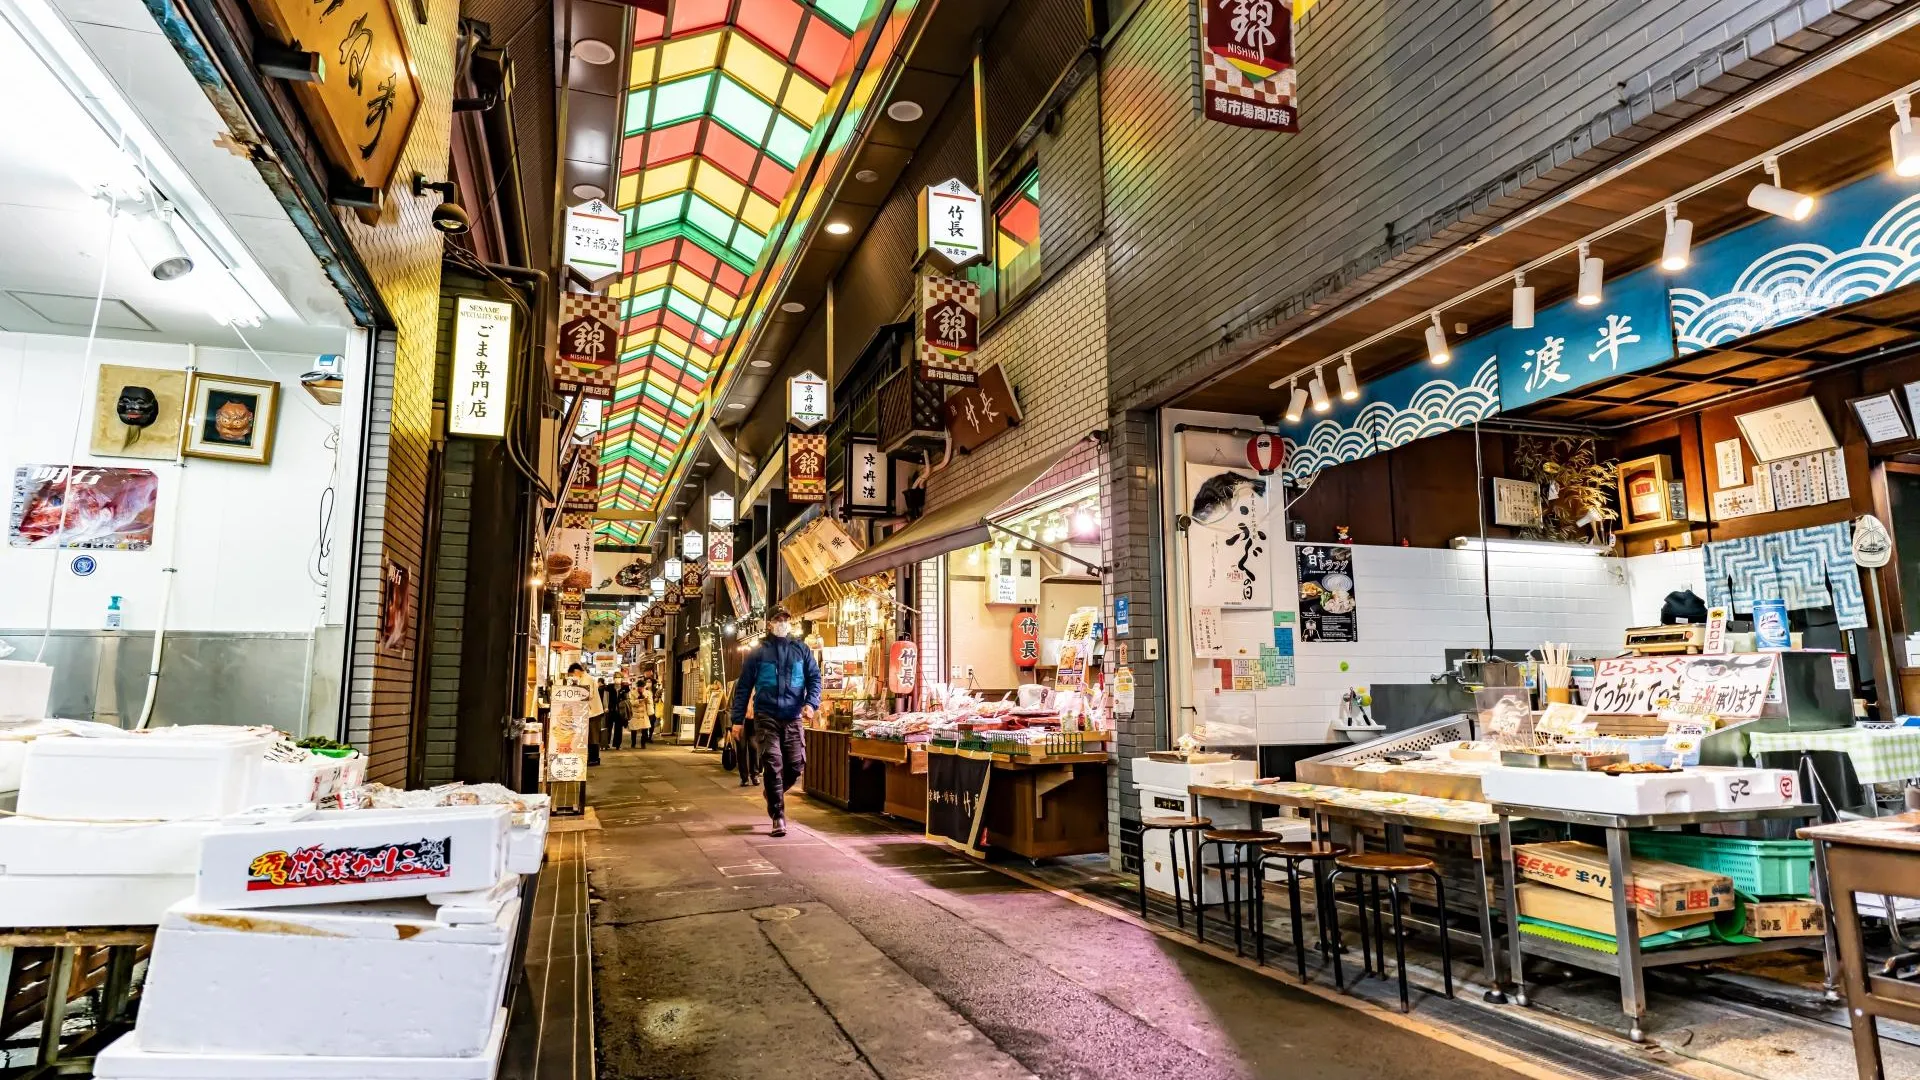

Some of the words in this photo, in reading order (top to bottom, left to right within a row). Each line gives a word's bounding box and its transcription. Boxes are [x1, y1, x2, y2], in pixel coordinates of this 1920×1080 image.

[1227, 43, 1260, 60] NISHIKI
[1214, 97, 1290, 126] 錦市場商店街
[948, 205, 964, 237] 竹長
[469, 304, 500, 314] SESAME
[568, 321, 605, 362] 錦
[933, 305, 967, 350] 錦
[570, 353, 592, 362] NISHIKI
[936, 339, 957, 348] NISHIKI
[468, 325, 494, 418] ごま専門店
[927, 368, 975, 384] 錦市場商店街
[559, 382, 610, 396] 錦市商店街
[804, 384, 814, 413] 京丹波
[32, 467, 102, 485] 明石
[795, 451, 819, 479] 錦
[863, 453, 876, 498] 京丹波
[712, 543, 728, 562] 錦
[1020, 617, 1038, 660] 竹長
[899, 648, 916, 686] 竹長
[1601, 658, 1687, 676] とらふぐ
[288, 847, 416, 882] 松葉がに
[1575, 869, 1612, 889] んま
